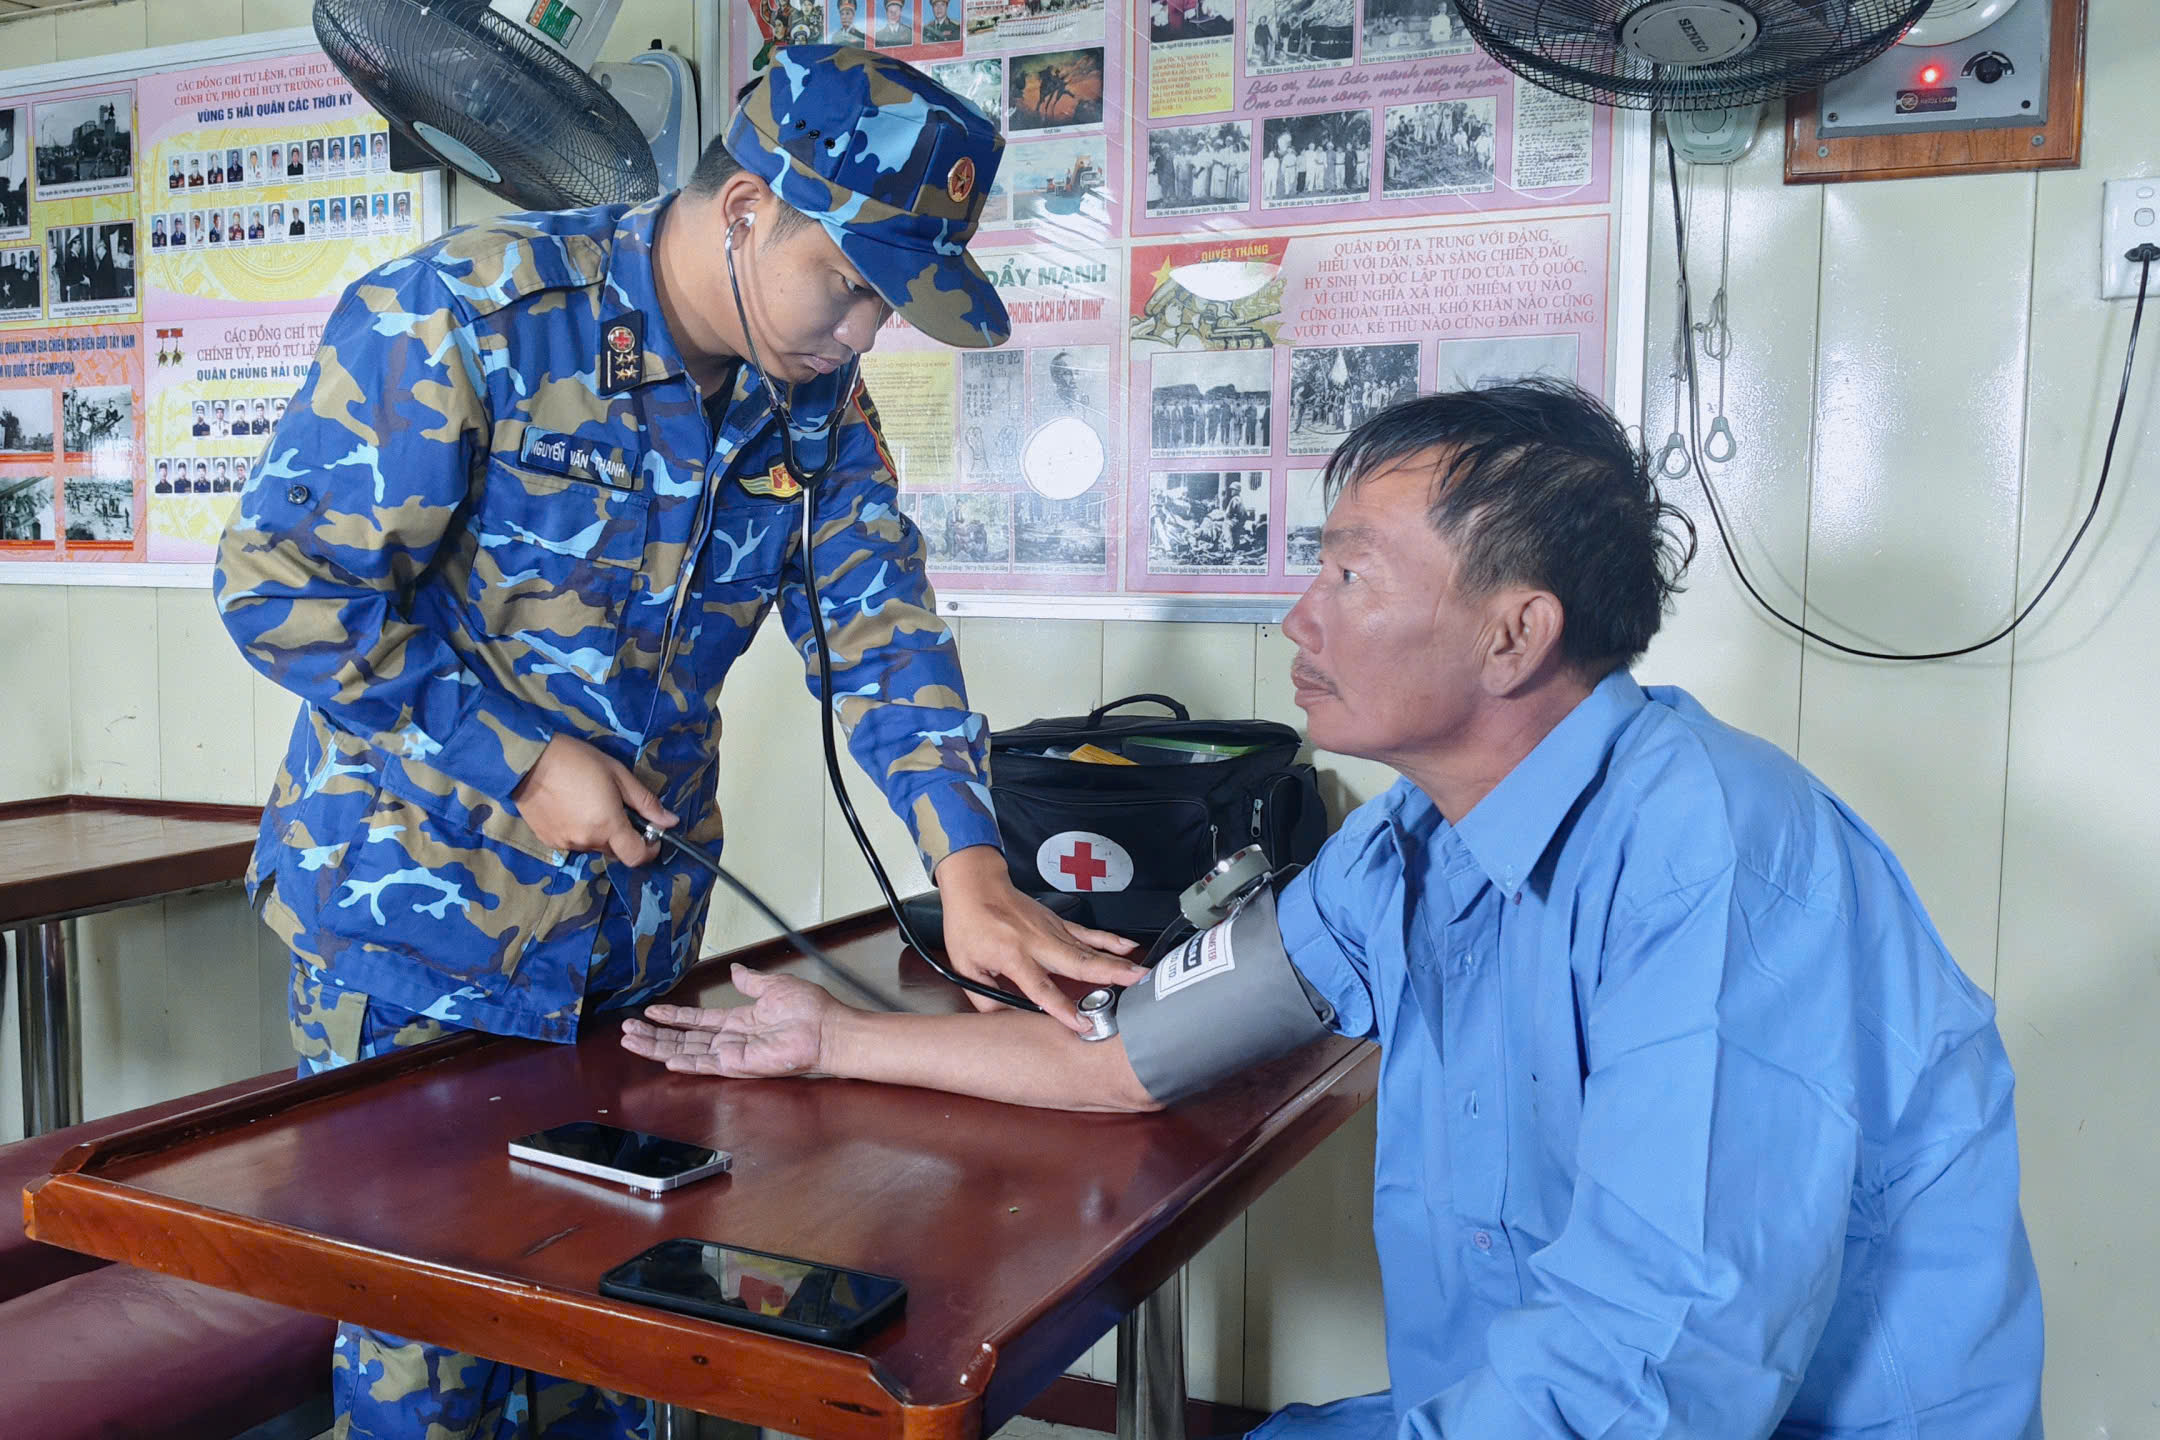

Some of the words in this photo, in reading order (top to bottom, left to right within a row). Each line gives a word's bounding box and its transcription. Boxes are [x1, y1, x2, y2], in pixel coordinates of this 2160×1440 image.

[1679, 18, 1709, 53] SENKO
[174, 92, 203, 106] CHÍNH
[222, 86, 241, 100] PHÓ
[262, 84, 281, 95] HUY
[284, 76, 324, 93] TRƯỞNG
[176, 80, 195, 92] CÁC
[196, 75, 222, 90] ĐỒNG
[225, 73, 241, 86] CHÍ
[243, 71, 256, 83] TƯ
[308, 63, 328, 75] HUY
[1247, 79, 1278, 95] Bác
[1337, 71, 1369, 87] Bác
[197, 108, 225, 123] VÙNG
[227, 107, 234, 120] 5
[236, 101, 253, 118] HẢI
[257, 99, 285, 117] QUÂN
[288, 96, 309, 112] CÁC
[312, 92, 336, 109] THỜI
[1297, 95, 1329, 107] non
[1201, 246, 1233, 262] QUYẾT
[1235, 241, 1269, 258] THẮNG
[1334, 239, 1373, 257] QUÂN
[1376, 236, 1401, 254] ĐỘI
[1404, 238, 1422, 251] TA
[1426, 233, 1475, 250] TRUNG
[1479, 230, 1505, 246] VỚI
[1508, 226, 1553, 244] ĐẢNG,
[1317, 254, 1349, 273] HIẾU
[1353, 255, 1377, 270] VỚI
[1380, 253, 1412, 269] DÂN,
[1416, 250, 1445, 267] SẴN
[1450, 248, 1487, 266] SÀNG
[1490, 242, 1534, 262] CHIẾN
[1538, 240, 1568, 259] ĐẤU
[1038, 263, 1107, 289] MẠNH
[1304, 276, 1322, 290] HY
[1326, 274, 1358, 289] SINH
[1362, 270, 1376, 286] VÌ
[1379, 269, 1407, 285] ĐỘC
[1411, 267, 1437, 284] LẬP
[1441, 268, 1461, 283] TỰ
[1462, 267, 1482, 281] DO
[1485, 262, 1515, 279] CỦA
[1520, 257, 1539, 277] TỔ
[1542, 254, 1588, 277] QUỐC,
[1314, 291, 1328, 305] VÌ
[1331, 287, 1358, 304] CHỦ
[1362, 285, 1405, 303] NGHĨA
[1409, 282, 1430, 300] XÃ
[1434, 281, 1463, 298] HỘI.
[1466, 279, 1512, 297] NHIỆM
[1516, 280, 1538, 295] VỤ
[1541, 276, 1572, 292] NÀO
[1008, 300, 1033, 324] PHONG
[1034, 295, 1055, 323] CÁCH
[1056, 291, 1067, 321] HỒ
[1300, 306, 1337, 322] CŨNG
[1340, 304, 1379, 320] HOÀN
[1383, 303, 1435, 318] THÀNH,
[1439, 298, 1469, 315] KHÓ
[1472, 296, 1513, 314] KHĂN
[1517, 293, 1548, 310] NÀO
[1552, 292, 1594, 308] CŨNG
[224, 326, 247, 343] CÁC
[249, 323, 281, 342] ĐỒNG
[284, 322, 305, 340] CHÍ
[1293, 323, 1329, 338] VƯỢT
[1331, 322, 1364, 337] QUA,
[1366, 317, 1385, 335] KẺ
[1388, 316, 1417, 333] THÙ
[1422, 316, 1451, 332] NÀO
[1454, 314, 1495, 330] CŨNG
[1498, 311, 1539, 328] ĐÁNH
[1543, 308, 1599, 326] THẮNG.
[38, 339, 48, 353] GIA
[109, 332, 120, 349] TÂY
[121, 334, 136, 349] NAM
[196, 344, 233, 361] CHÍNH
[236, 343, 255, 361] ỦY,
[257, 342, 281, 358] PHÓ
[283, 343, 300, 358] TƯ
[302, 340, 318, 360] LỆ
[196, 367, 227, 381] QUÂN
[230, 362, 268, 380] CHỦNG
[271, 360, 290, 378] HẢI
[293, 364, 309, 378] QU
[532, 440, 566, 463] NGUYỄN
[569, 449, 589, 470] VĂN
[594, 456, 627, 478] THANH
